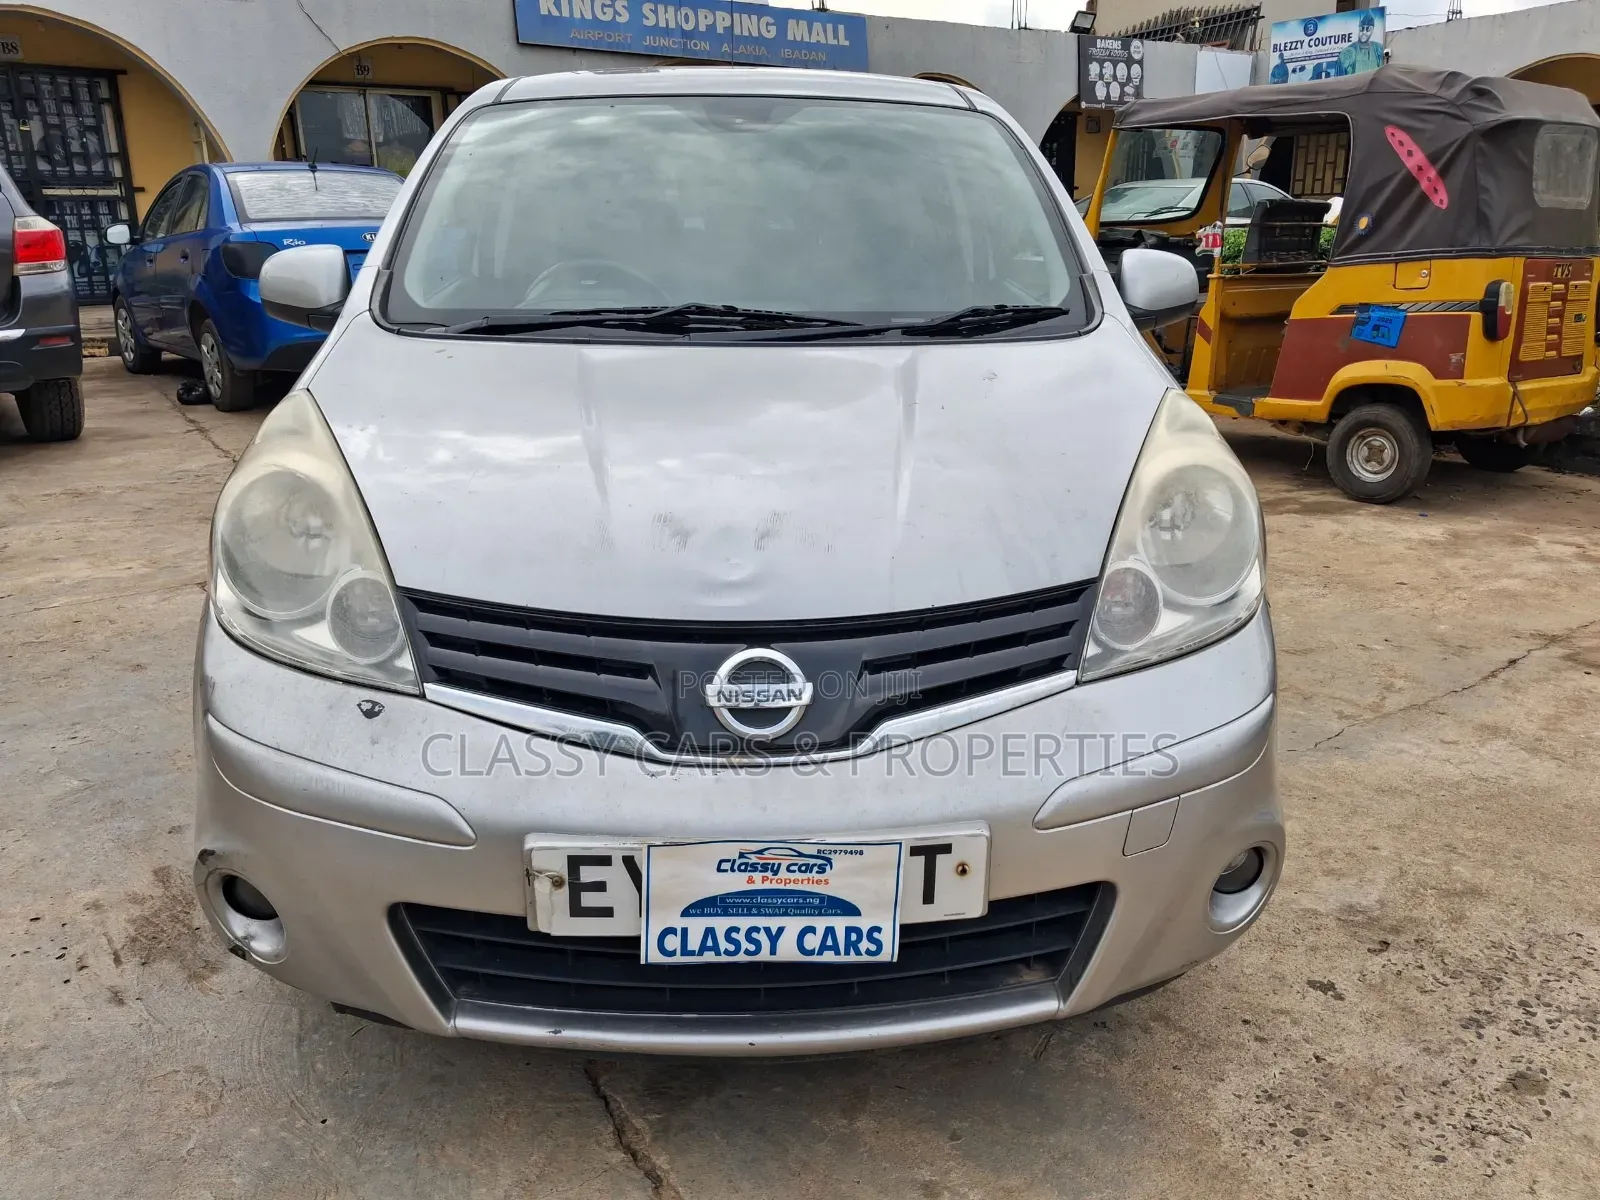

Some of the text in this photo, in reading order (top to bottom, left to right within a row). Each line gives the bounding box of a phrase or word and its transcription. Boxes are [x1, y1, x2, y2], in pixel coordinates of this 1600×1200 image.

[538, 0, 850, 46] KINGS SHOPPING MALL
[0, 41, 19, 55] B8
[570, 28, 632, 44] AIRPORT
[642, 35, 710, 51] JUNCTION
[781, 48, 826, 62] IBADAN
[1272, 39, 1305, 53] BLEZZY
[1307, 32, 1353, 48] COUTURE
[355, 64, 370, 76] B9
[282, 238, 306, 247] Rio
[365, 233, 378, 242] KI
[1553, 262, 1572, 278] TVS
[715, 687, 804, 704] NISSAN
[816, 848, 865, 856] RC2979498
[716, 859, 829, 876] Classy cars
[746, 875, 830, 887] & Properties
[725, 896, 820, 904] www.classycars.ng
[704, 907, 724, 915] BUY,
[787, 907, 820, 916] Quality
[821, 907, 844, 915] Cars.
[656, 925, 884, 957] CLASSY CARS
